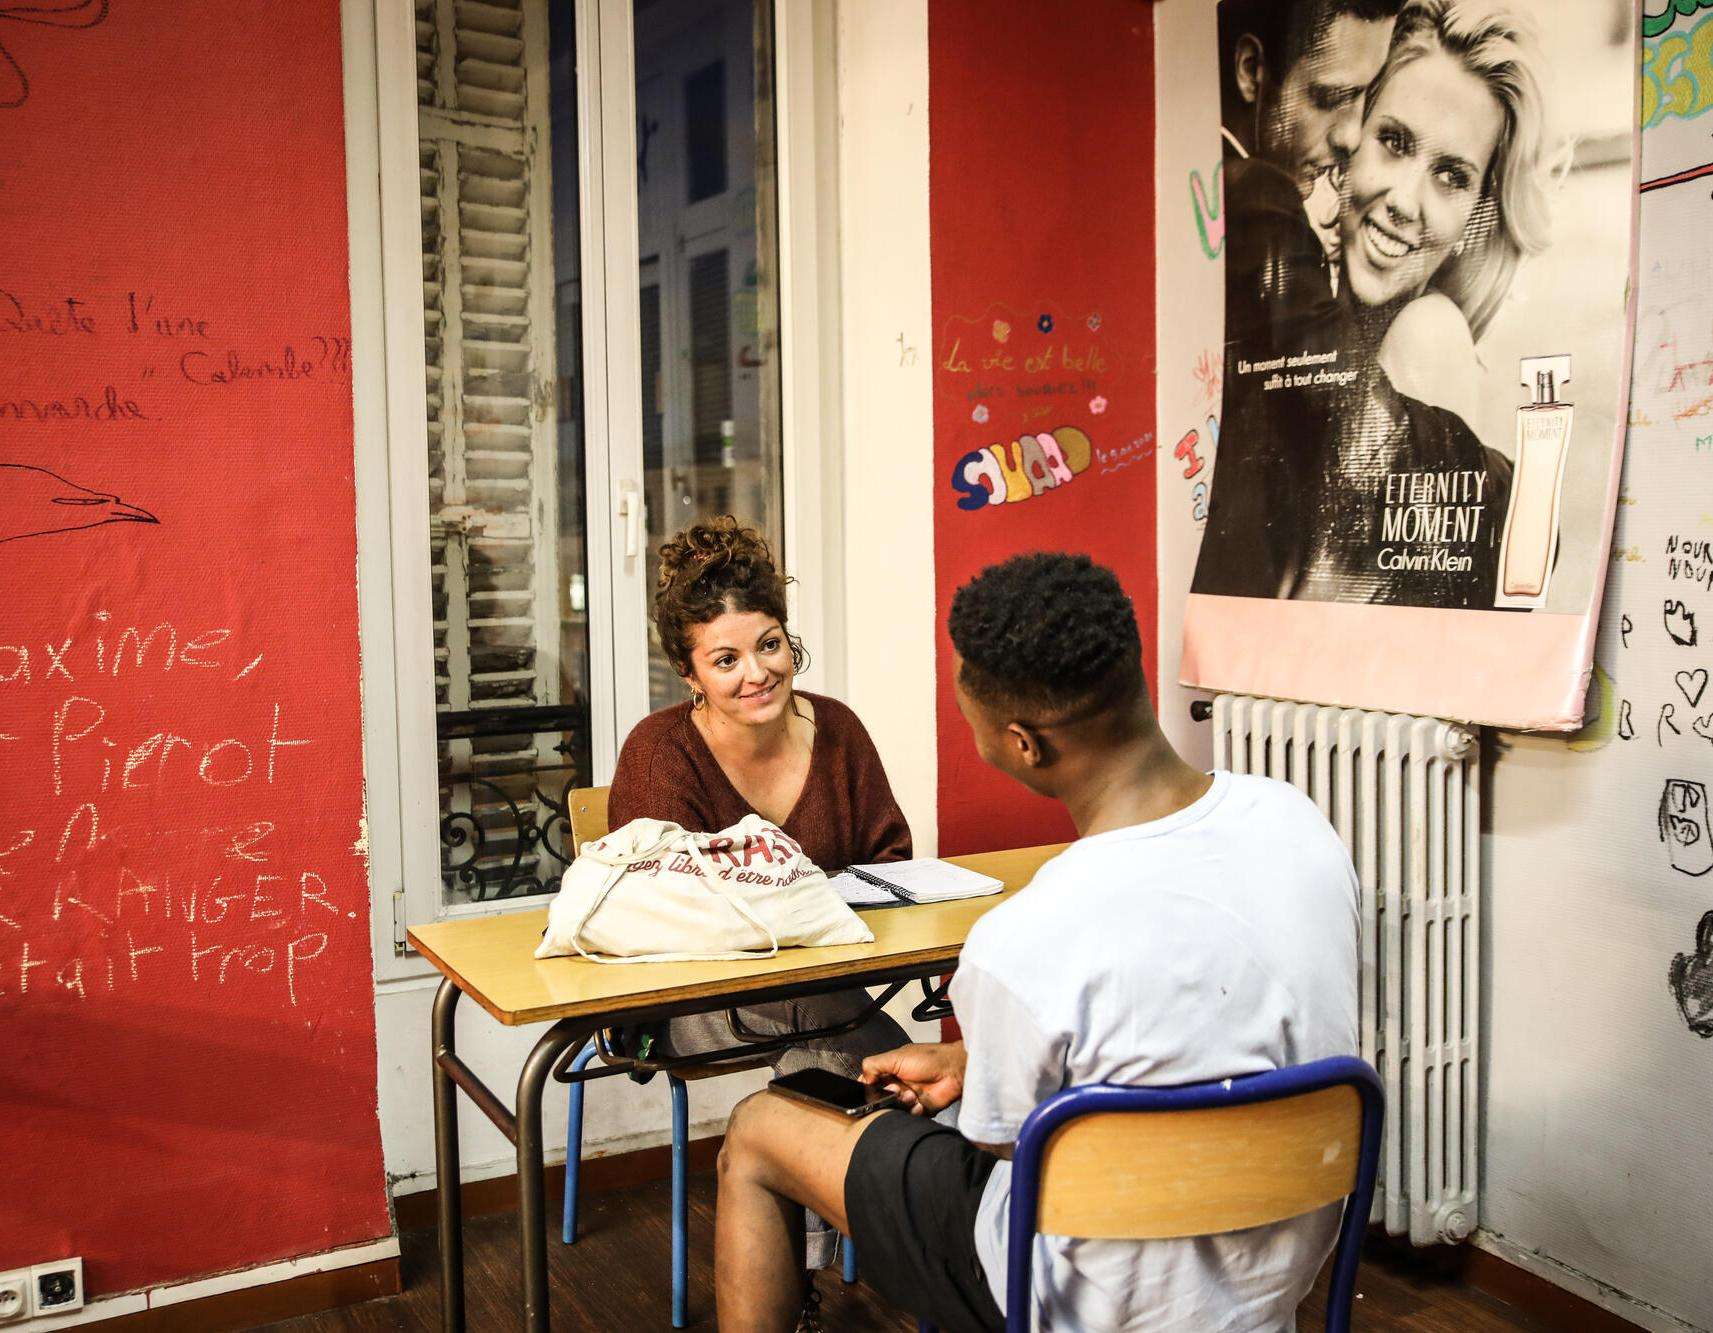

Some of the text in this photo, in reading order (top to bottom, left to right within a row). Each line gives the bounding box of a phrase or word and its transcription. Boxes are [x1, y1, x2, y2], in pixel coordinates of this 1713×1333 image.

[1238, 350, 1338, 375] Un moment seulement
[1293, 372, 1312, 387] tout
[1313, 368, 1359, 386] changer
[1385, 470, 1488, 504] ETERNITY
[1381, 505, 1486, 543] MOMENT
[1377, 547, 1473, 572] Calvin Klein
